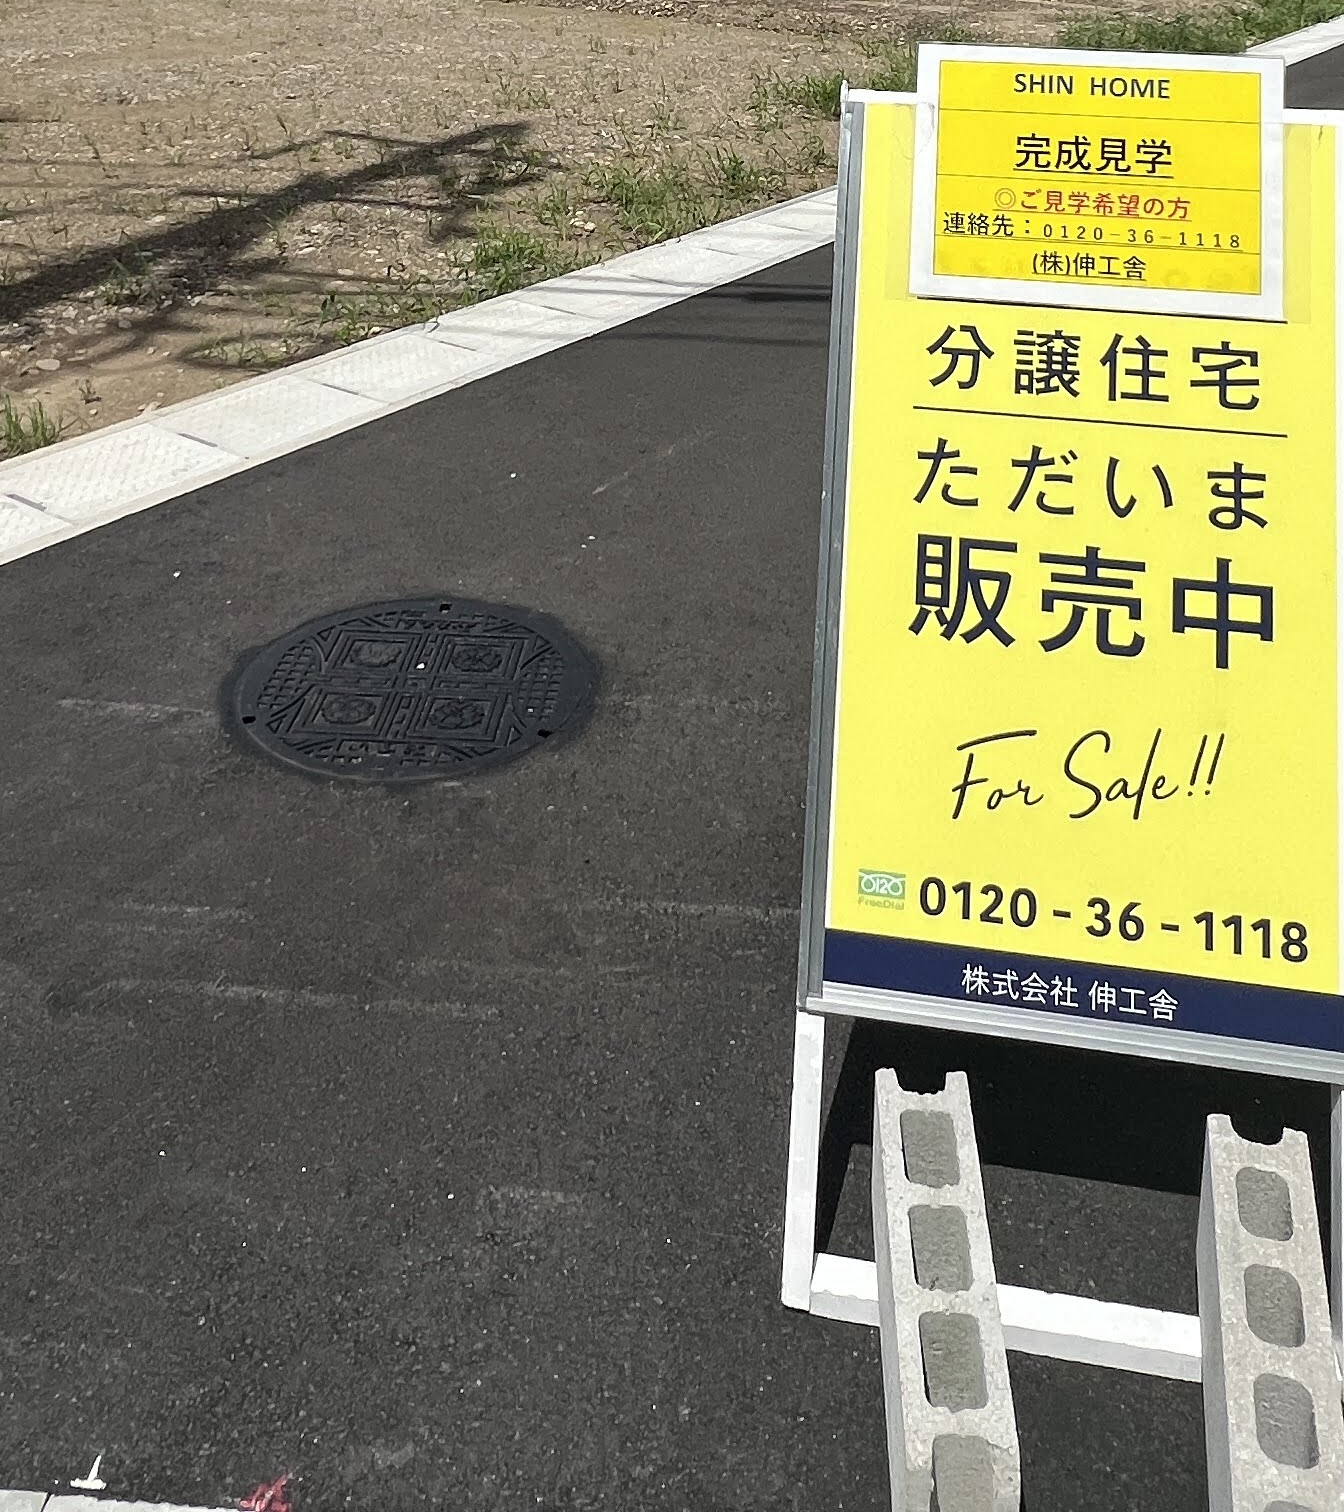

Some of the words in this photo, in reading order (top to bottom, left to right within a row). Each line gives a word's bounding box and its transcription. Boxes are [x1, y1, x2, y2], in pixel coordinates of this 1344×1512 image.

[1013, 73, 1075, 96] SHIN
[1090, 77, 1171, 100] HOME
[1014, 132, 1172, 175] 完成見学
[925, 324, 1261, 411] 分譲住宅
[913, 437, 1269, 530] ただいま
[908, 533, 1274, 670] 販売中
[950, 729, 1044, 820] For
[1062, 726, 1224, 820] Sale!!
[960, 963, 1078, 1010] 株式会社
[1088, 979, 1179, 1022] 伸工舎
